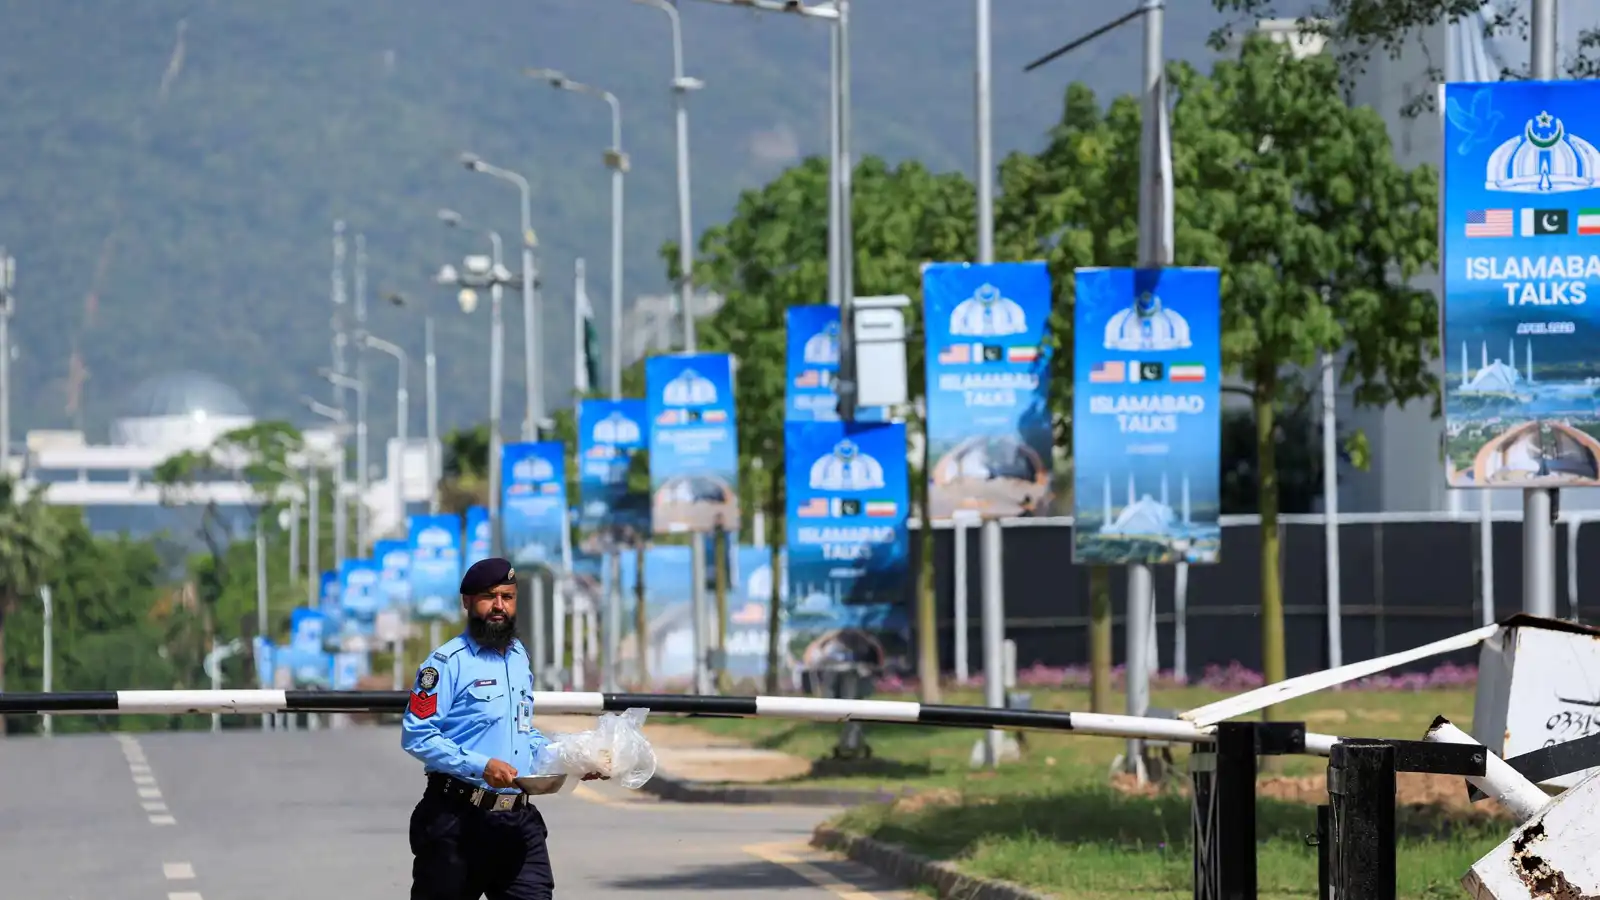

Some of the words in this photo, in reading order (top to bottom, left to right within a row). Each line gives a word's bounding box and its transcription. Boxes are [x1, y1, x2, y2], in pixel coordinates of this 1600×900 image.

[1466, 256, 1600, 280] ISLAMABA
[1503, 282, 1587, 306] TALKS
[1089, 395, 1205, 414] ISLAMABAD
[1118, 414, 1177, 433] TALKS
